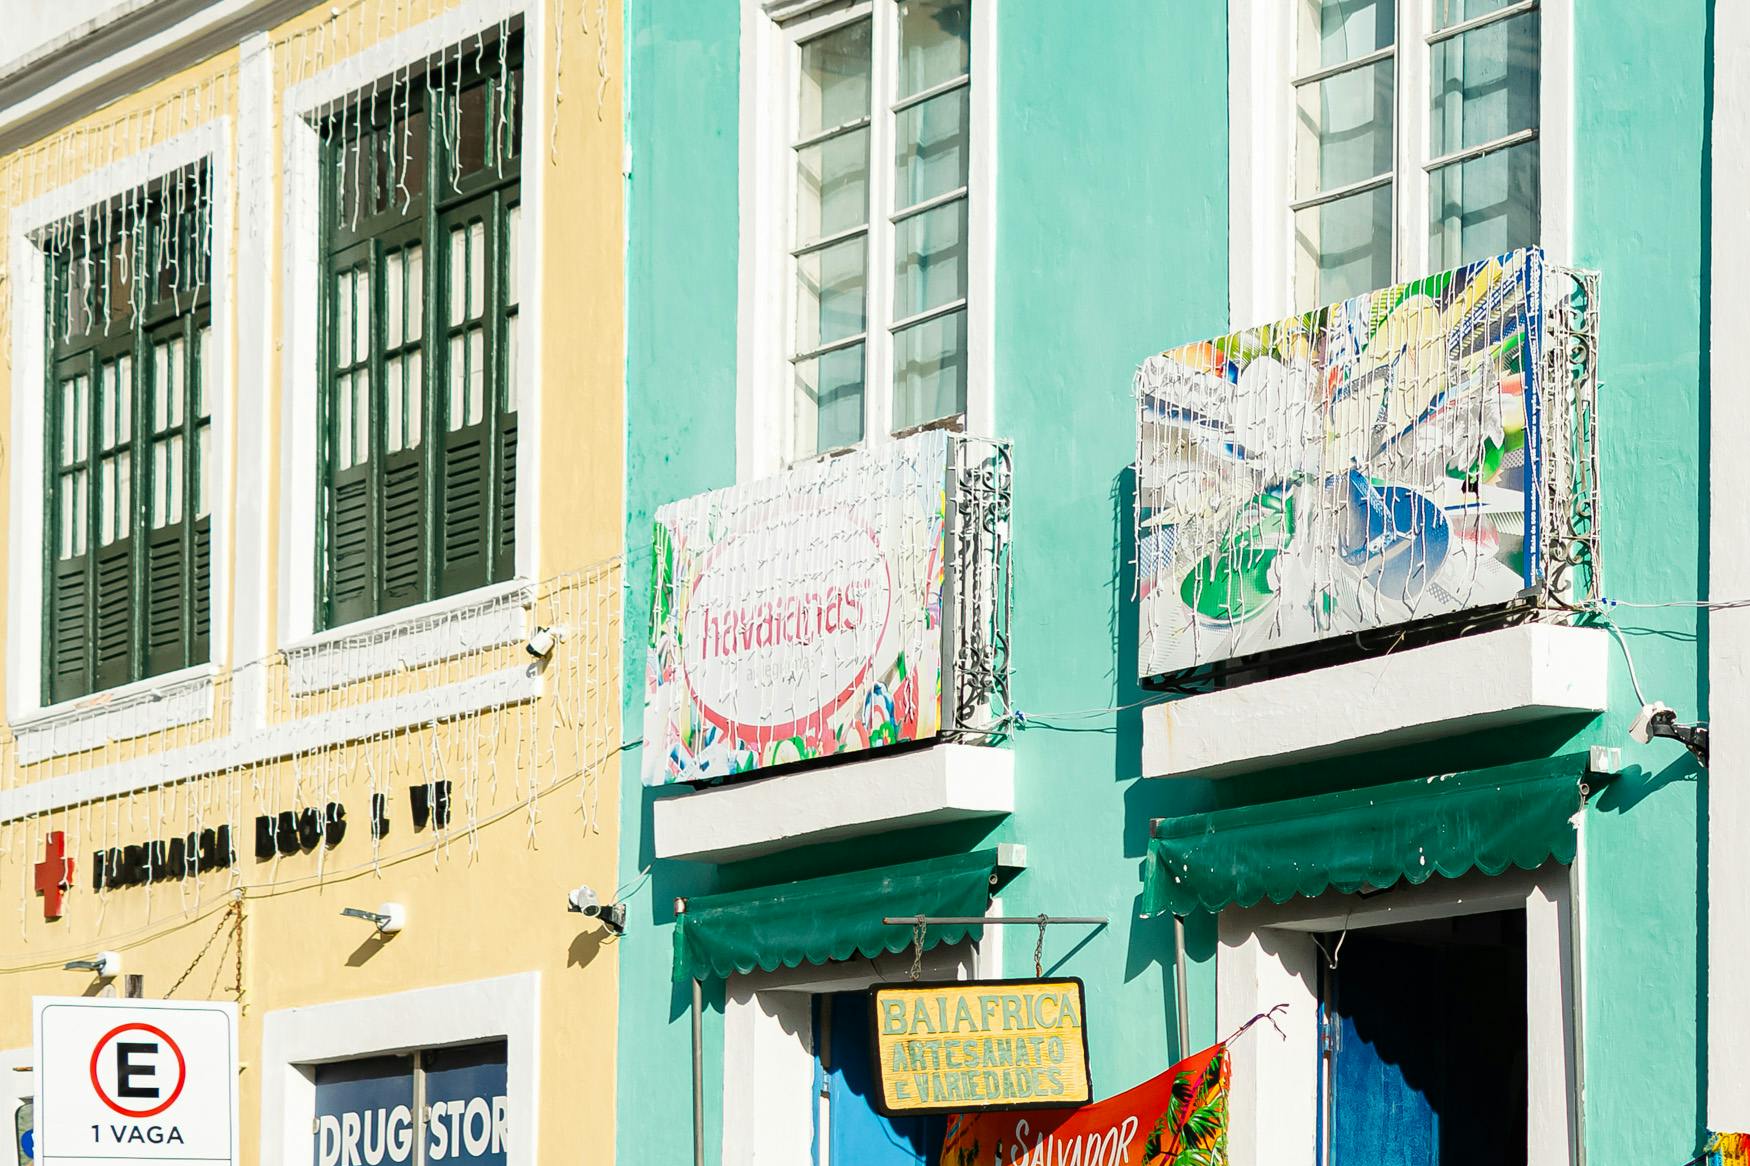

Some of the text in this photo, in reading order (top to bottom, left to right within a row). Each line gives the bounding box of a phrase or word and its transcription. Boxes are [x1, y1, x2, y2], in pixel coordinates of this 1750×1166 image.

[880, 992, 1080, 1036] BAIAFRICA
[117, 1042, 160, 1098] E
[892, 1036, 1066, 1073] ARTESANATO
[914, 1068, 1066, 1103] VARIEDADES
[91, 1124, 184, 1144] 1 VAGA
